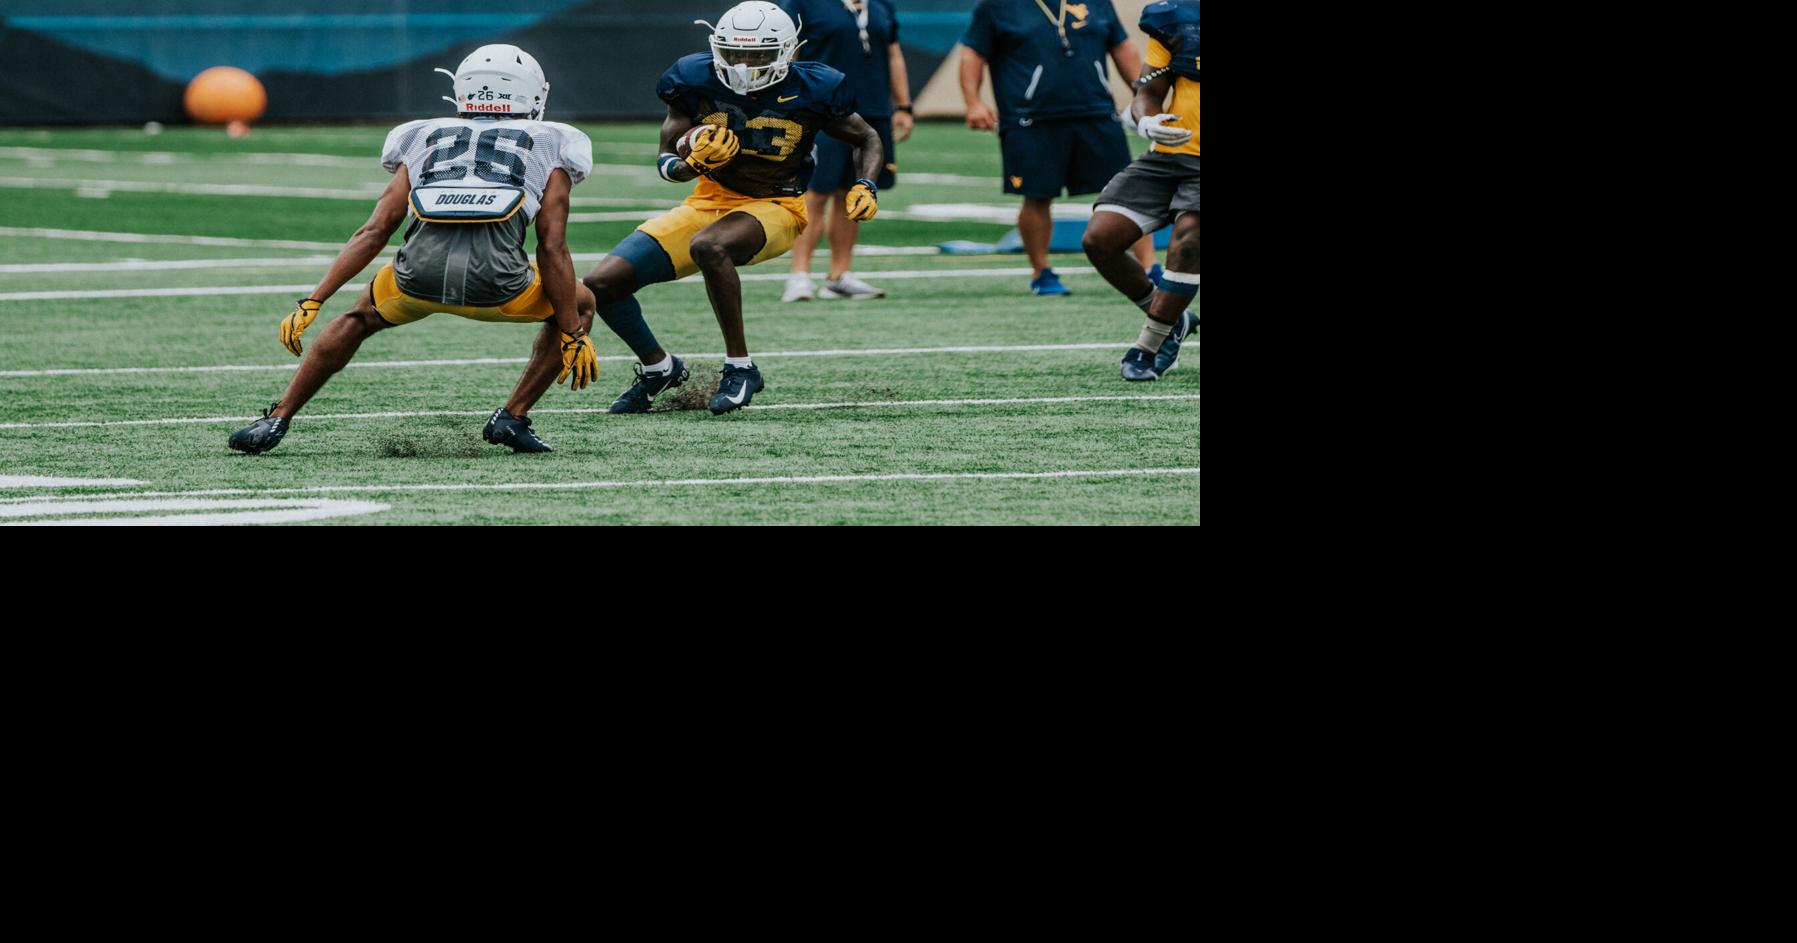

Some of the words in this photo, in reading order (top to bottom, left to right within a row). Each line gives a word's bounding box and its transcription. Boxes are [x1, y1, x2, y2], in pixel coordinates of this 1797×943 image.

[477, 90, 494, 101] 26
[466, 103, 512, 112] Riddell
[419, 126, 535, 187] 26
[435, 193, 496, 205] DOUGLAS
